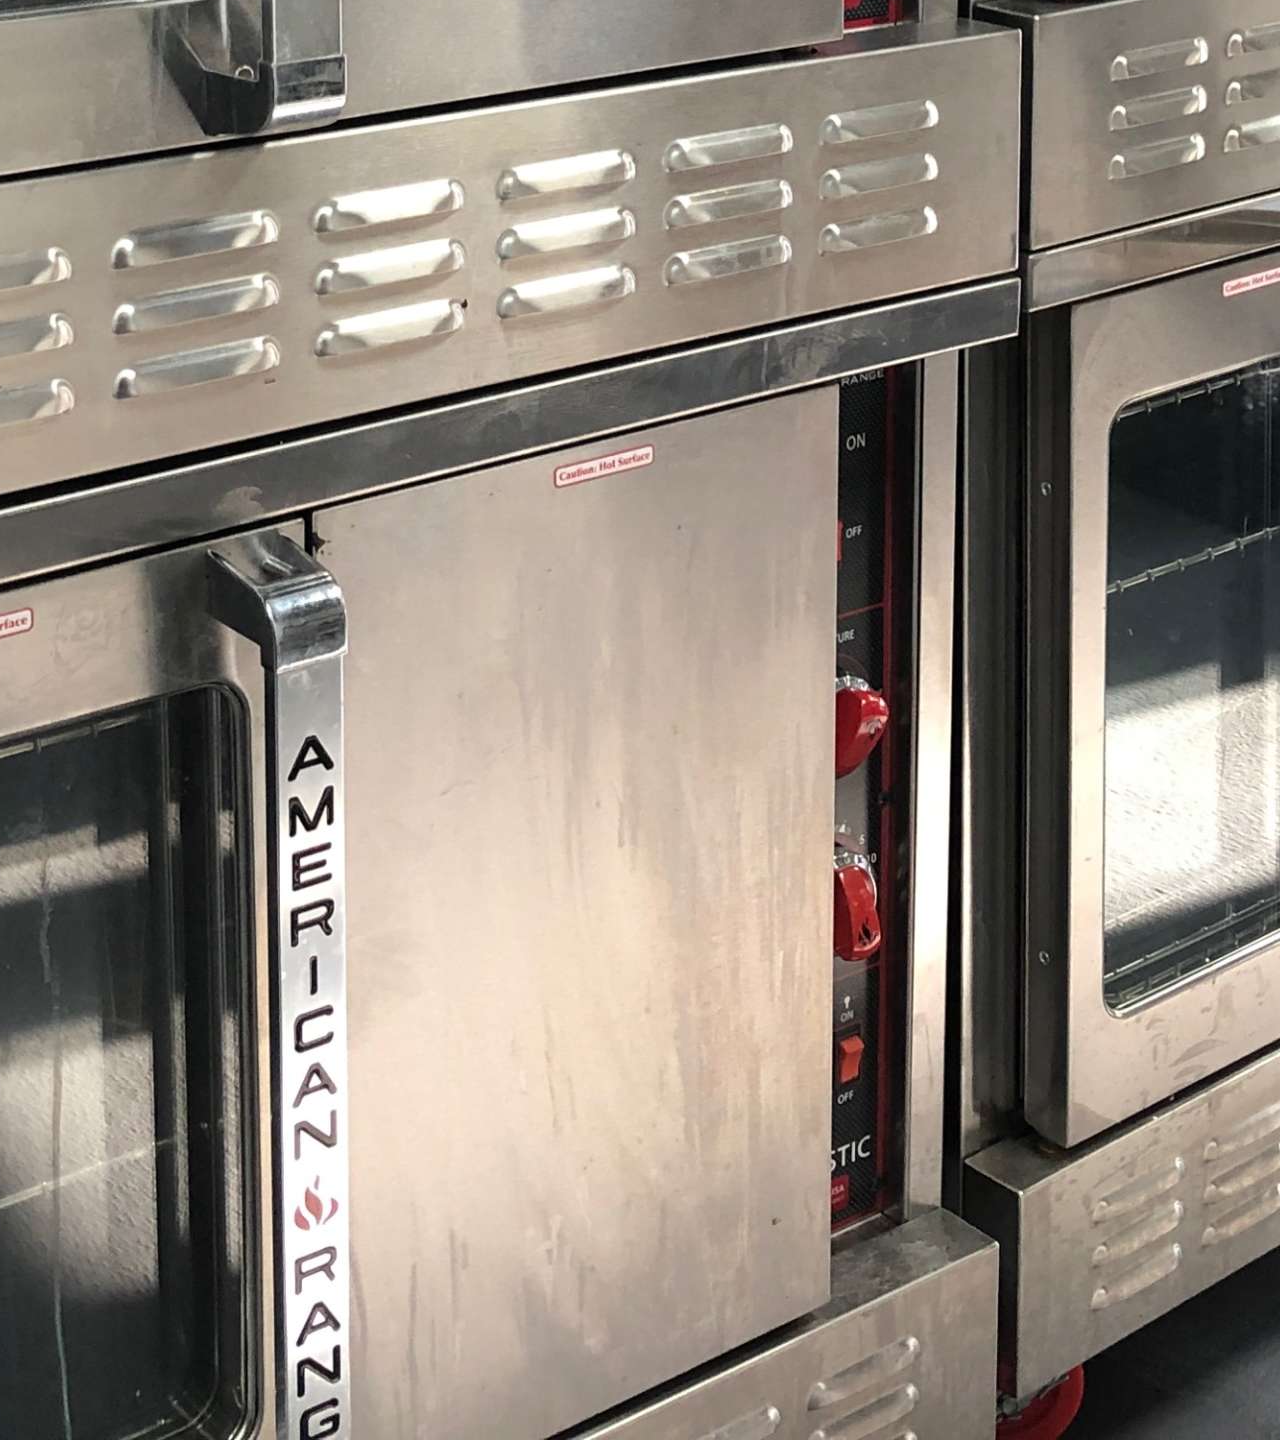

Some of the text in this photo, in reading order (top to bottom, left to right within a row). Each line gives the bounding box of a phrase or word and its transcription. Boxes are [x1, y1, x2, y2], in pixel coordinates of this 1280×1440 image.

[846, 432, 866, 451] ON
[599, 459, 616, 471] Hot
[618, 452, 651, 466] Surface
[845, 525, 863, 539] OFF
[837, 628, 855, 643] URE
[288, 735, 338, 1160] AMERICAN
[840, 1010, 854, 1022] ON
[837, 1090, 854, 1104] OFF
